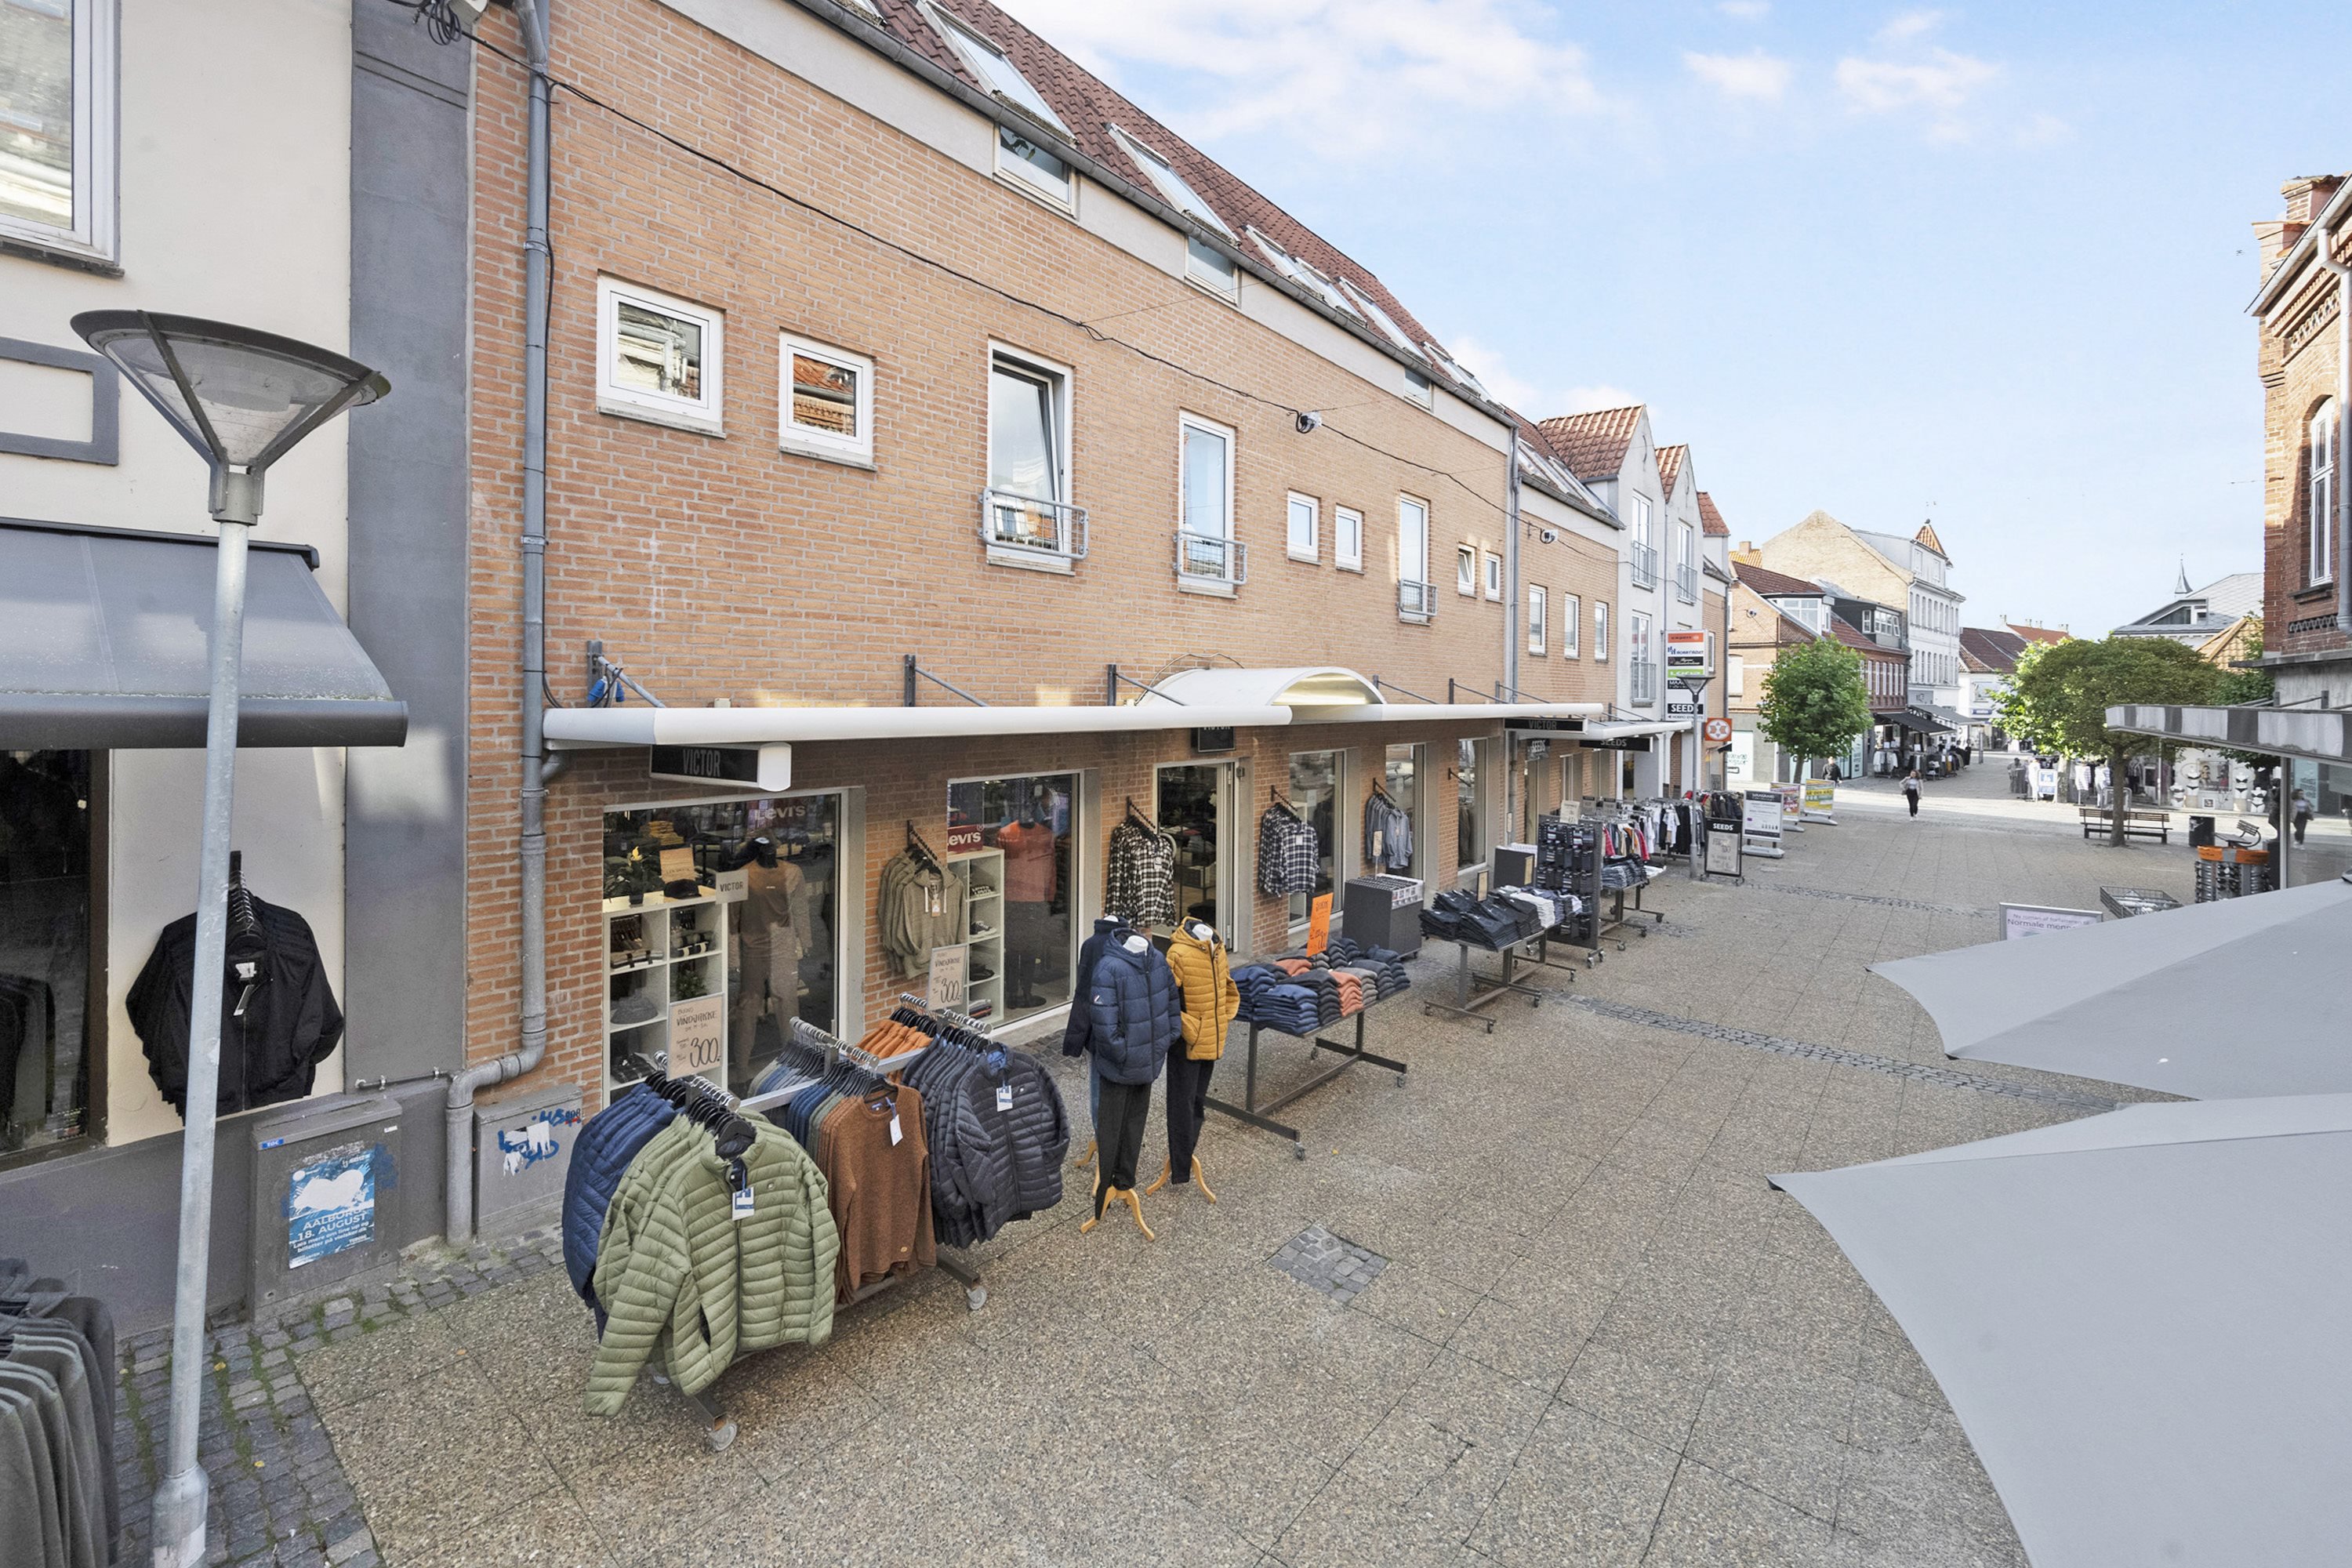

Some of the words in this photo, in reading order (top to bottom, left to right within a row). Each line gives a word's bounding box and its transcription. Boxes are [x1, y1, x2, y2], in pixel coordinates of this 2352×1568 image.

[1671, 704, 1699, 713] SEED
[1529, 720, 1557, 730] VICTOR
[683, 749, 720, 777] VICTOR
[947, 832, 982, 846] evi's
[720, 881, 744, 892] VICTOR
[2007, 918, 2044, 929] Normale
[297, 1229, 315, 1242] 18.
[318, 1214, 367, 1235] AUGUST
[326, 1231, 337, 1240] om
[351, 1223, 361, 1233] up
